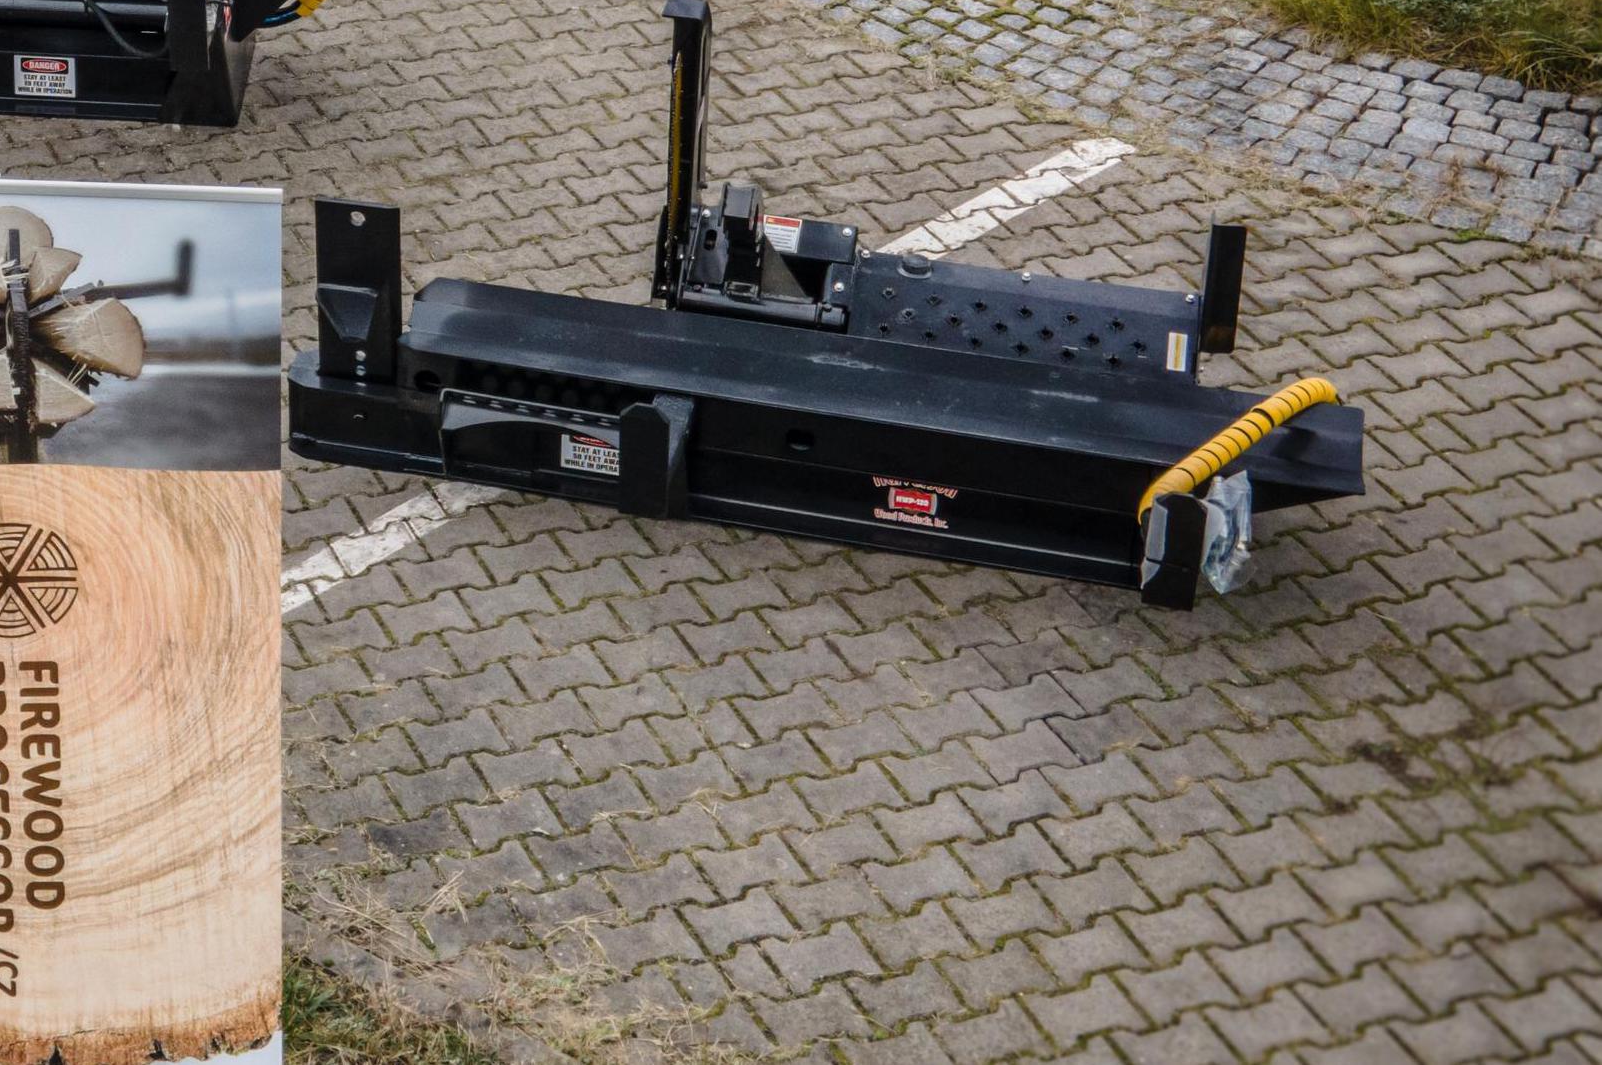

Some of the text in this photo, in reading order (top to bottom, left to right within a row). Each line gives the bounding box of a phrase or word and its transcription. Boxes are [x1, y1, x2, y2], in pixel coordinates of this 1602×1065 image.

[29, 61, 60, 71] DANGER
[584, 454, 601, 462] FEET
[564, 459, 585, 467] WHILE
[596, 464, 619, 472] OPERA
[18, 660, 66, 910] FIREWOOD
